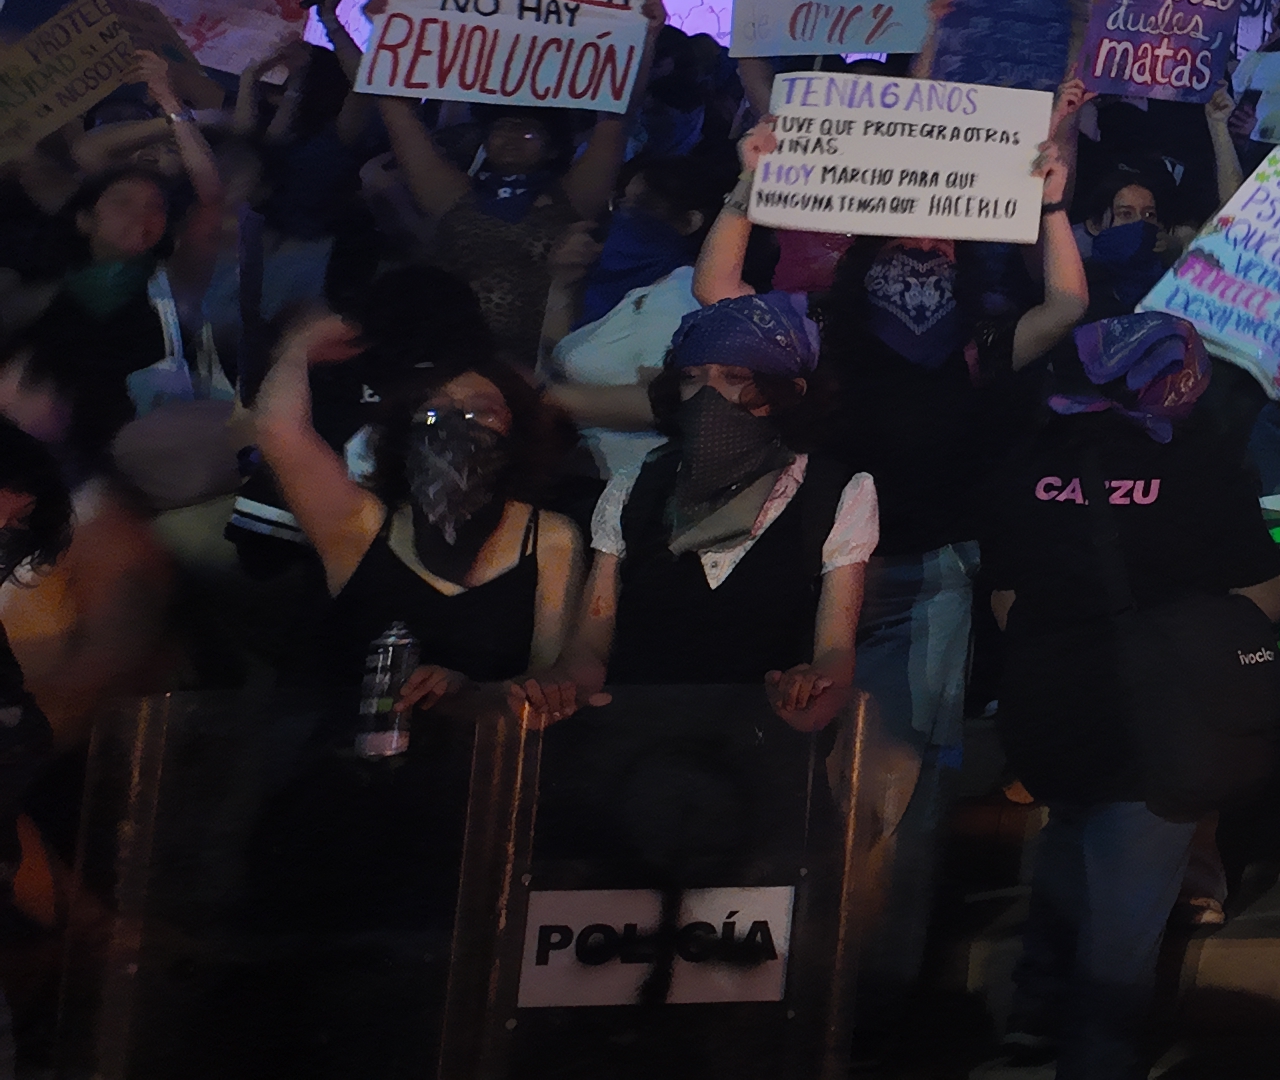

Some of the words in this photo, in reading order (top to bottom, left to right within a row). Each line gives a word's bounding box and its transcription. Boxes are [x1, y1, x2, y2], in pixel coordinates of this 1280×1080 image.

[366, 11, 636, 103] REVOLUCIÓN
[1093, 37, 1213, 92] matas
[880, 82, 901, 110] 6
[903, 80, 979, 116] AÑOS
[819, 117, 855, 139] QUE
[963, 125, 1021, 147] OTRAS
[761, 161, 816, 187] HOY
[820, 165, 894, 186] MARCHO
[897, 167, 940, 189] PARA
[944, 171, 980, 190] QUE
[754, 190, 834, 213] NINGUNA
[839, 194, 888, 215] TENGA
[888, 196, 918, 215] QUE
[927, 194, 1018, 220] HACERLO
[1034, 475, 1161, 507] CAZU
[534, 910, 780, 967] POLCÍA
